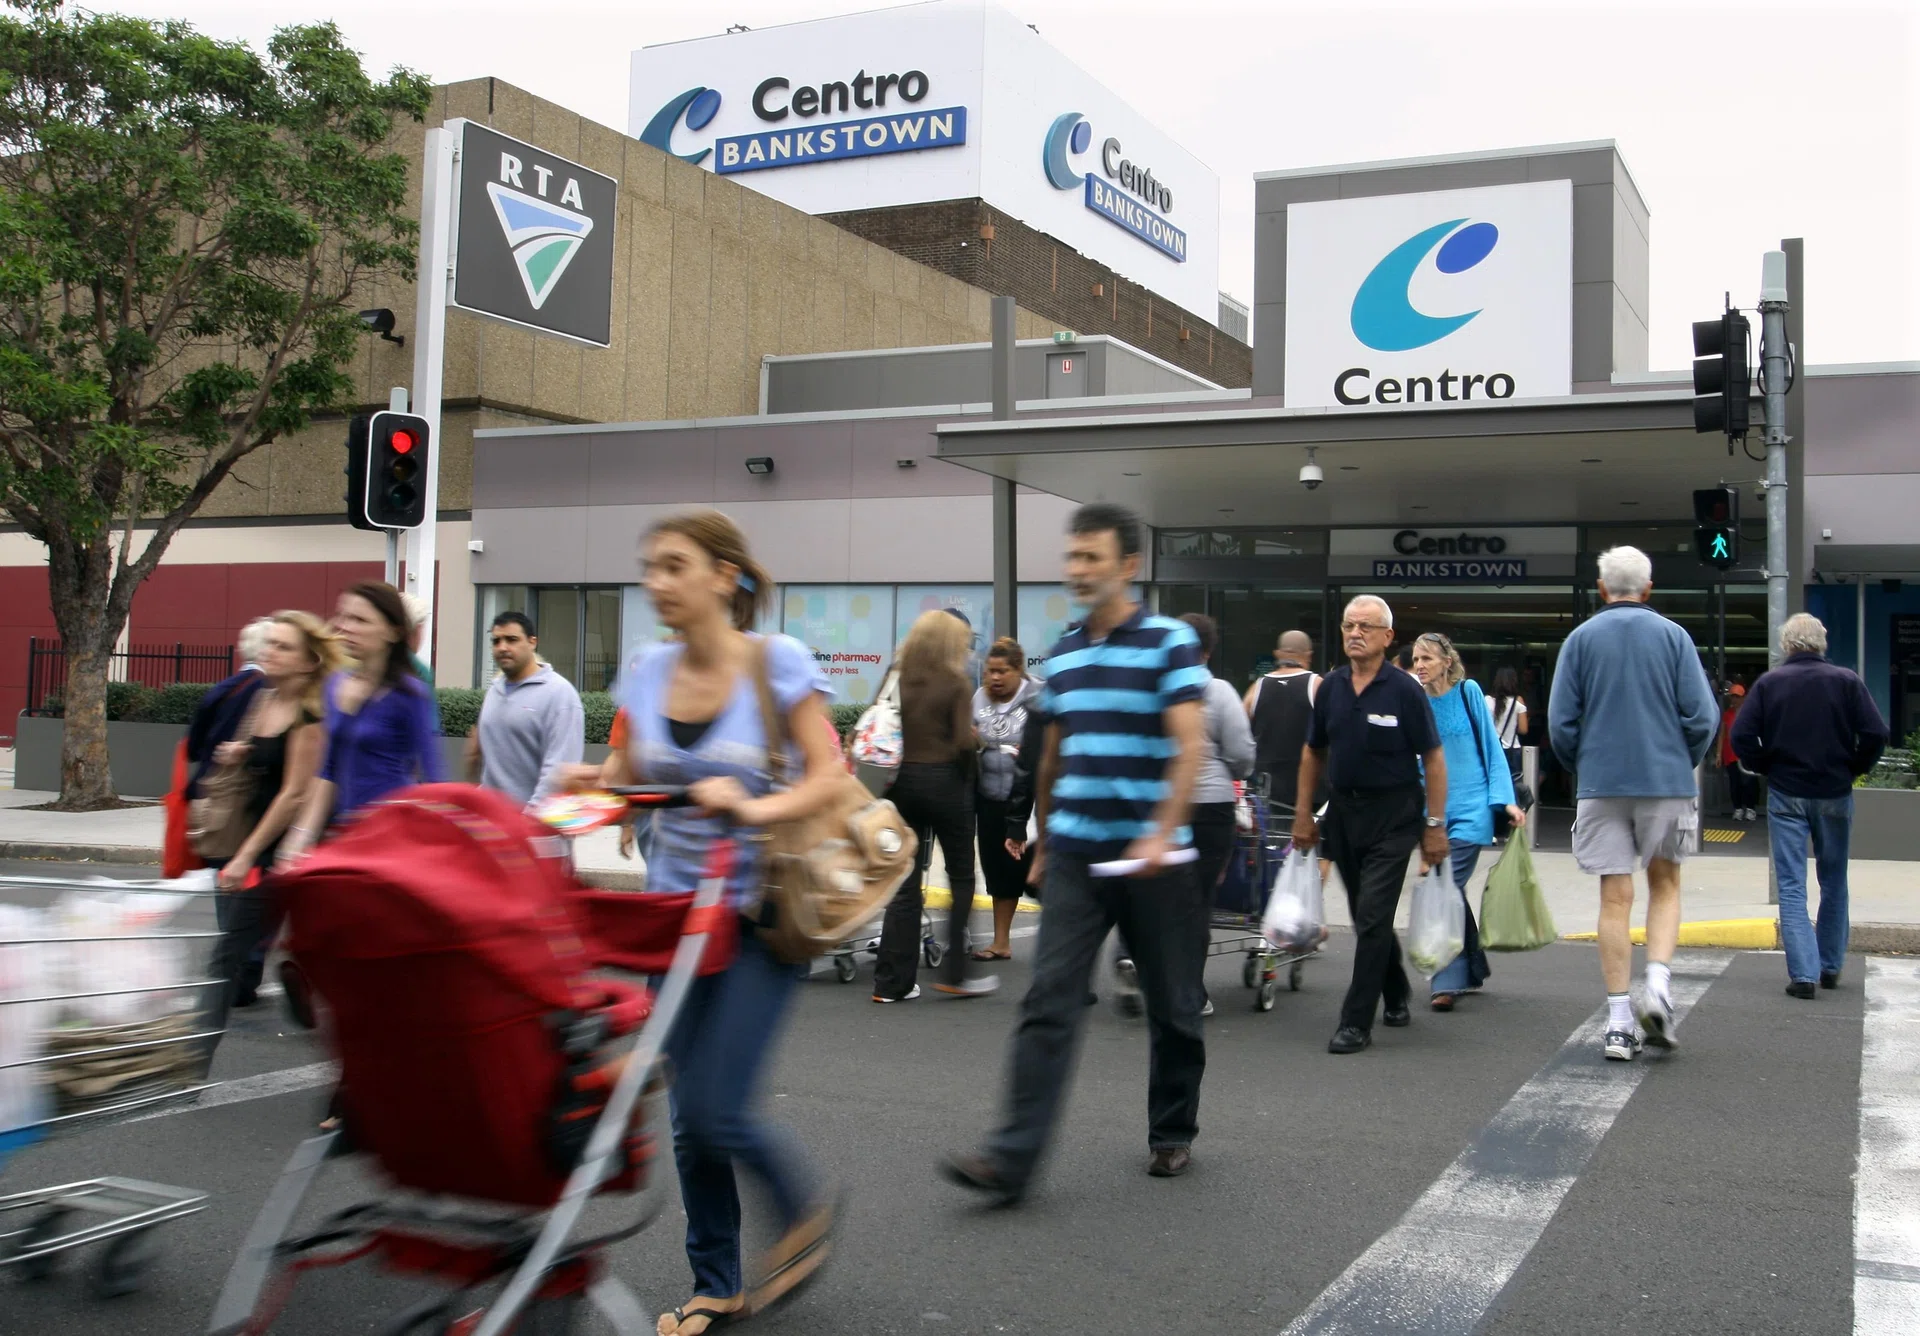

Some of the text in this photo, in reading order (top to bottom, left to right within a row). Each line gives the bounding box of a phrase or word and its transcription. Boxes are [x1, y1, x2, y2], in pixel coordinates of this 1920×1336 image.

[752, 68, 930, 122] Centro
[723, 113, 953, 167] BANKSTOWN
[501, 151, 583, 211] RTA
[1103, 137, 1174, 214] Centro
[1095, 181, 1184, 256] BANKSTOWN
[1334, 367, 1516, 406] Centro
[1393, 529, 1507, 556] Centro
[1376, 562, 1523, 577] BANKSTOWN
[832, 652, 881, 665] pharmacy
[845, 666, 859, 675] less
[1027, 655, 1047, 668] pric
